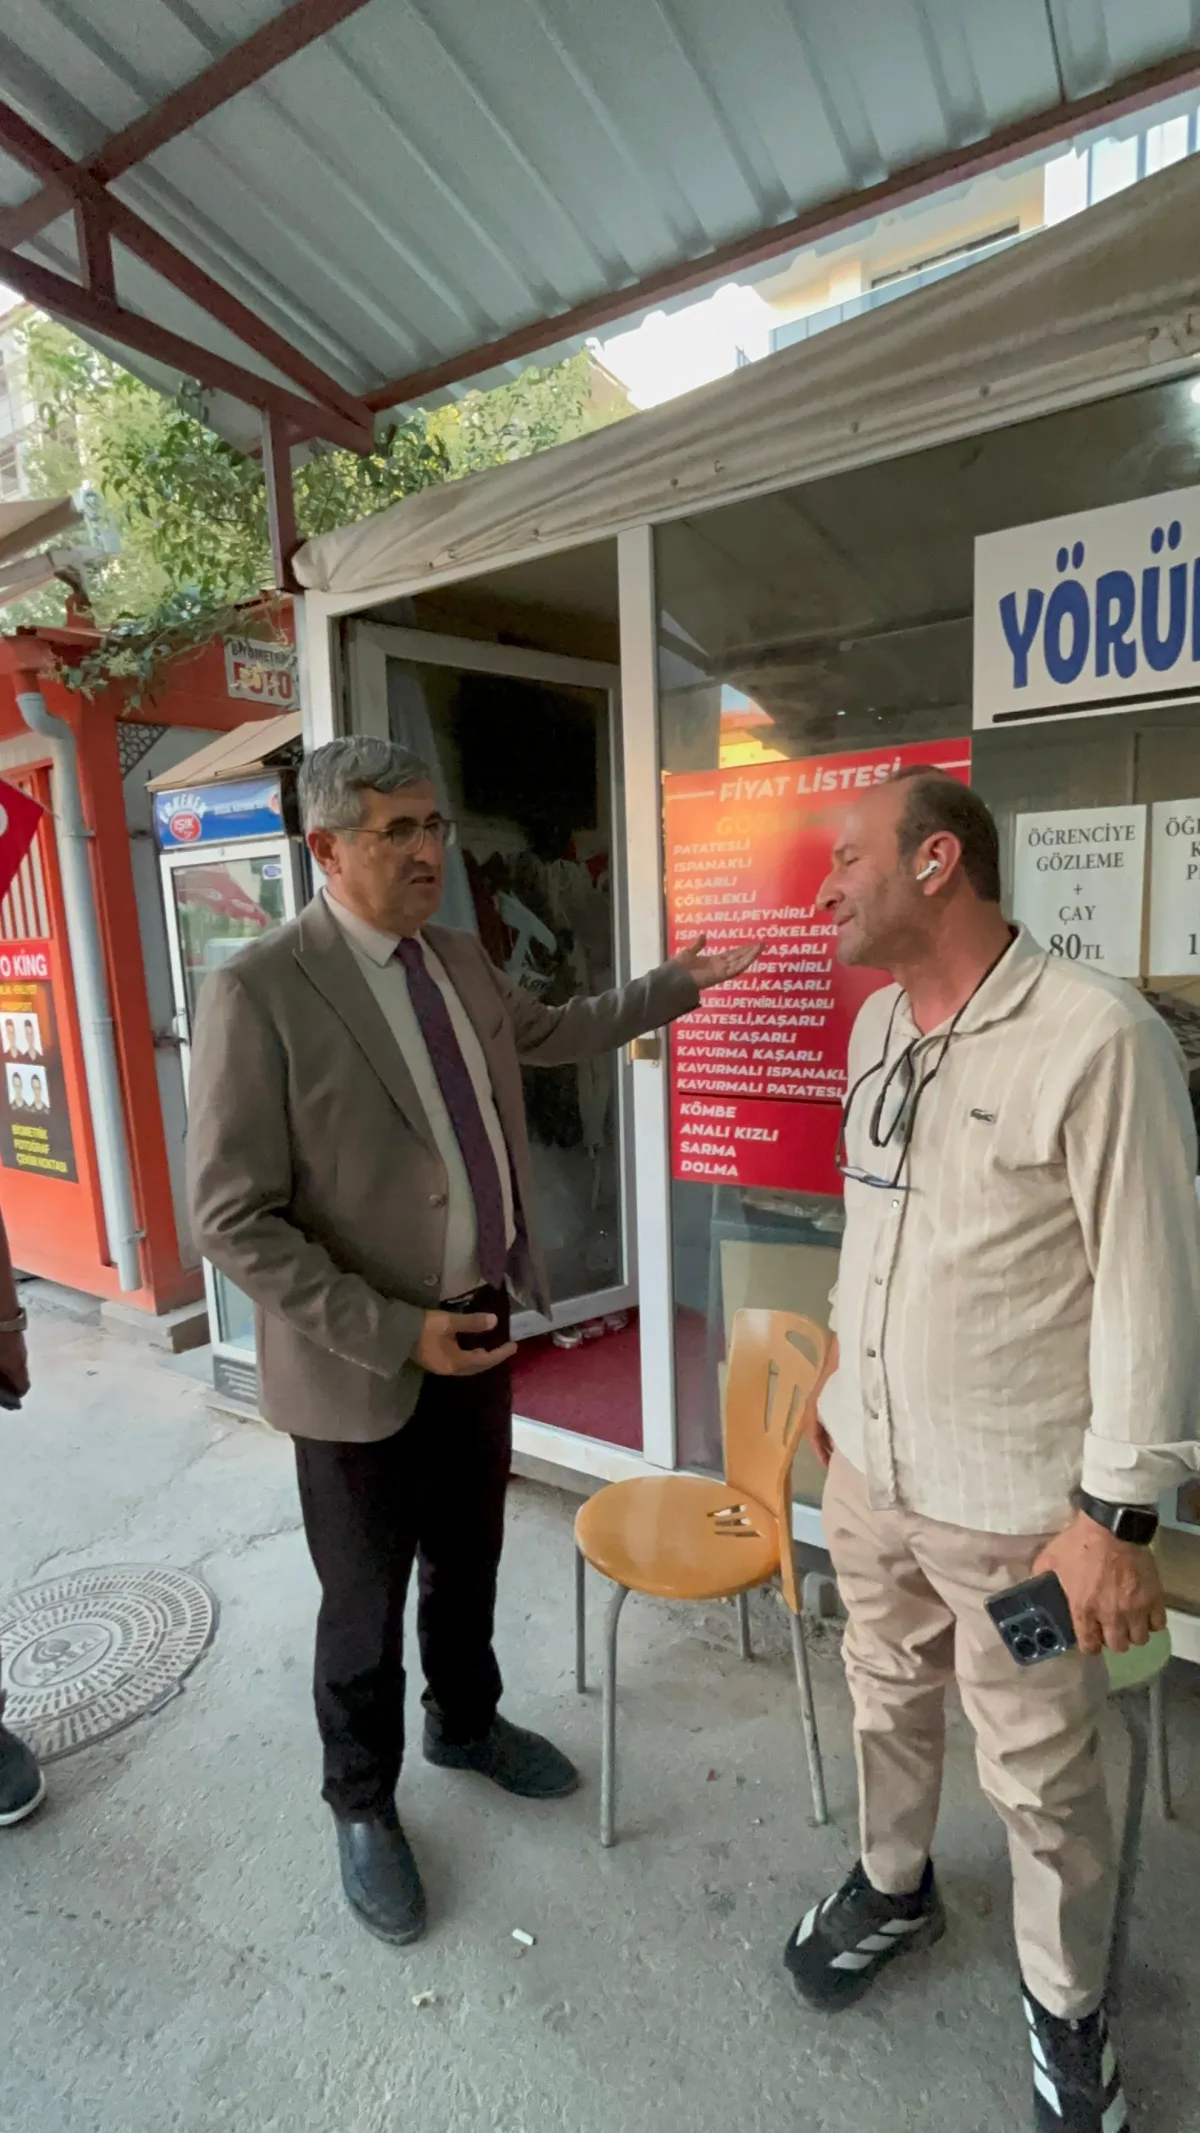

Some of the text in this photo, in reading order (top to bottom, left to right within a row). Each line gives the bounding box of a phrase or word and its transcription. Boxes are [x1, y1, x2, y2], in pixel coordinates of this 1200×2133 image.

[719, 757, 901, 802] FİYAT LİSTESİ
[1028, 823, 1136, 847] ÖĞRENCİYE
[1165, 816, 1200, 836] ÖĞ
[673, 840, 750, 856] PATATESLİ
[674, 857, 752, 873] ISPANAKLI
[1036, 852, 1124, 872] GÖZLEME
[674, 876, 738, 891] KAŞARLI
[675, 890, 756, 908] ÇÖKELEKLİ
[675, 905, 815, 925] KAŞARLI,PEYNİRLİ
[1059, 905, 1096, 925] ÇAY
[675, 924, 838, 940] ISPNAKLI,ÇÖKELEKL
[1050, 933, 1105, 960] 80TL
[677, 1030, 797, 1044] SUCUK KAŞARLI
[677, 1046, 823, 1062] KAVURMA KAŞARLI
[677, 1062, 848, 1080] KAVURMALI ISPANAKL
[677, 1079, 846, 1098] KAVURMALI PATATESL
[680, 1101, 737, 1118] KÖMBE
[680, 1123, 779, 1142] ANALI KIZLI
[680, 1140, 736, 1158] SARMA
[681, 1160, 738, 1176] DOLMA
